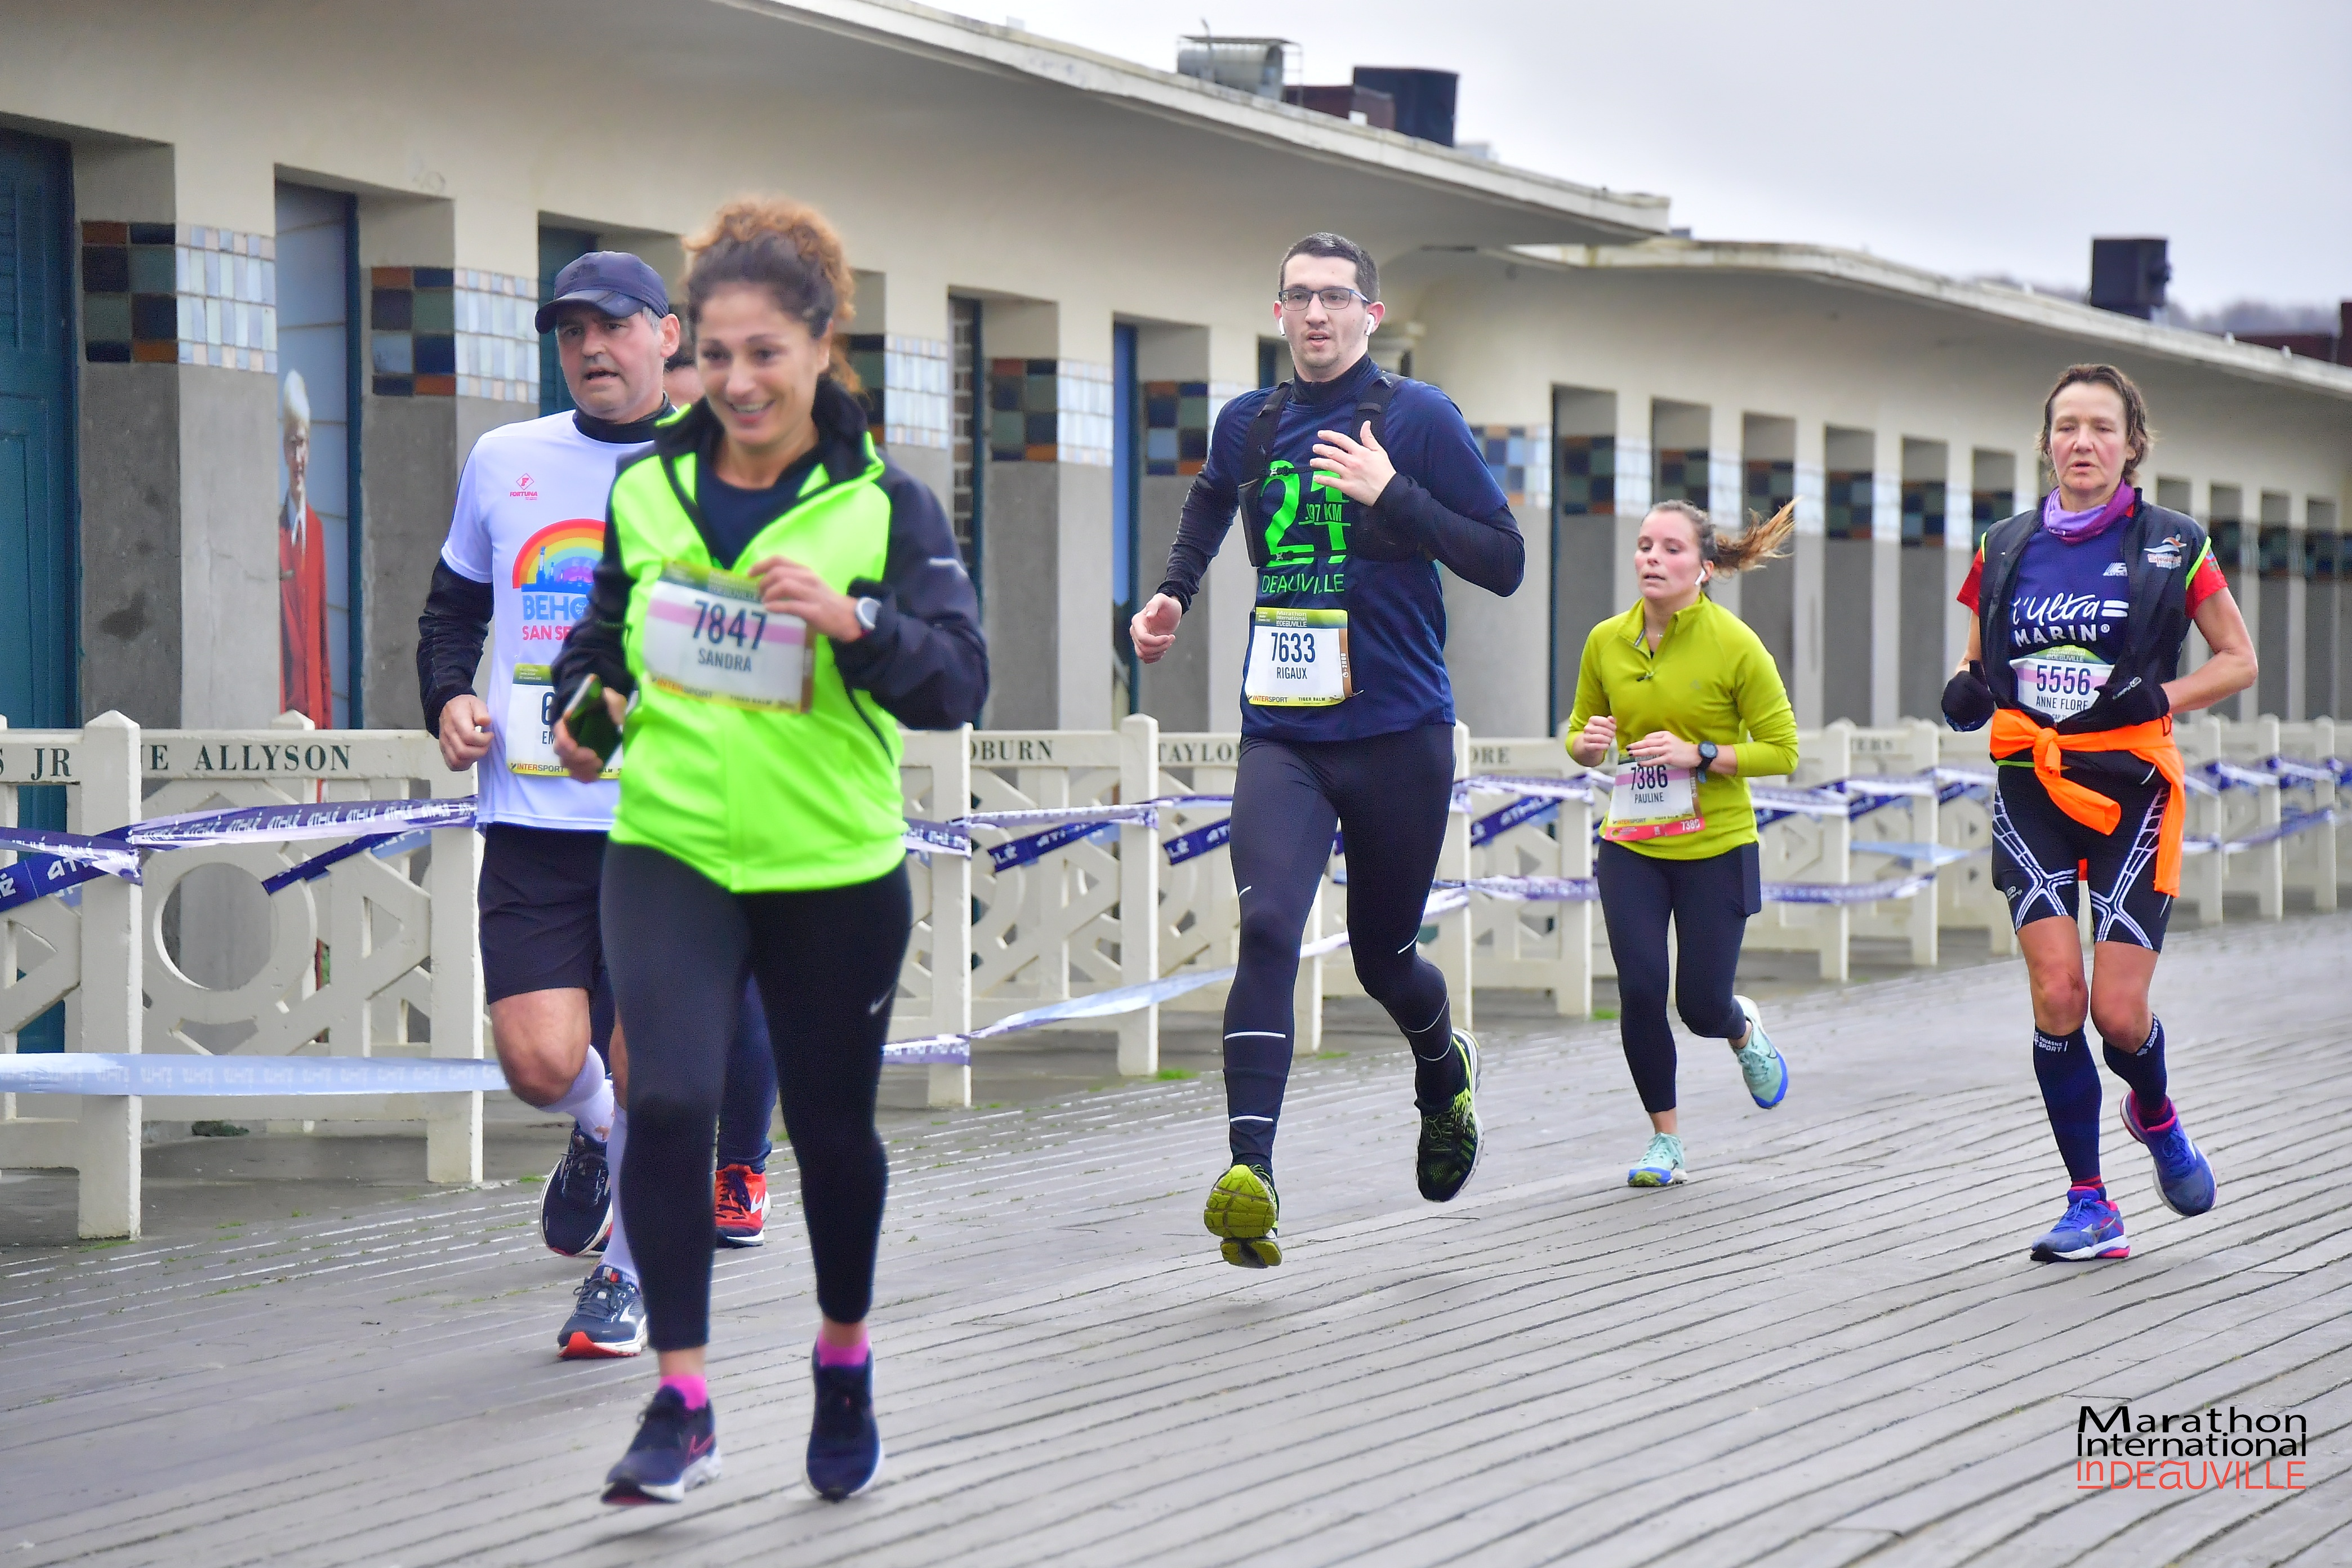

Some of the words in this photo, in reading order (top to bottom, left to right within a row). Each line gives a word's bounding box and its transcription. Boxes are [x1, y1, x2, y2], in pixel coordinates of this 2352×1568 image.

[1324, 504, 1342, 522] KM
[522, 625, 552, 640] SAN
[692, 599, 767, 651] 7847
[1271, 632, 1316, 663] 7633
[698, 648, 752, 672] SANDRA
[1276, 667, 1308, 680] RIGAUX
[2037, 664, 2091, 696] 5556
[2036, 696, 2057, 709] ANNE
[2060, 698, 2089, 711] FLORE
[30, 748, 72, 781] JR
[195, 744, 351, 771] ALLYSON
[516, 763, 563, 773] INTERSPORT
[1631, 764, 1668, 790] 7386
[1634, 792, 1664, 804] PAULINE
[2038, 1041, 2063, 1053] SPORT
[2039, 1036, 2063, 1047] THUASNE
